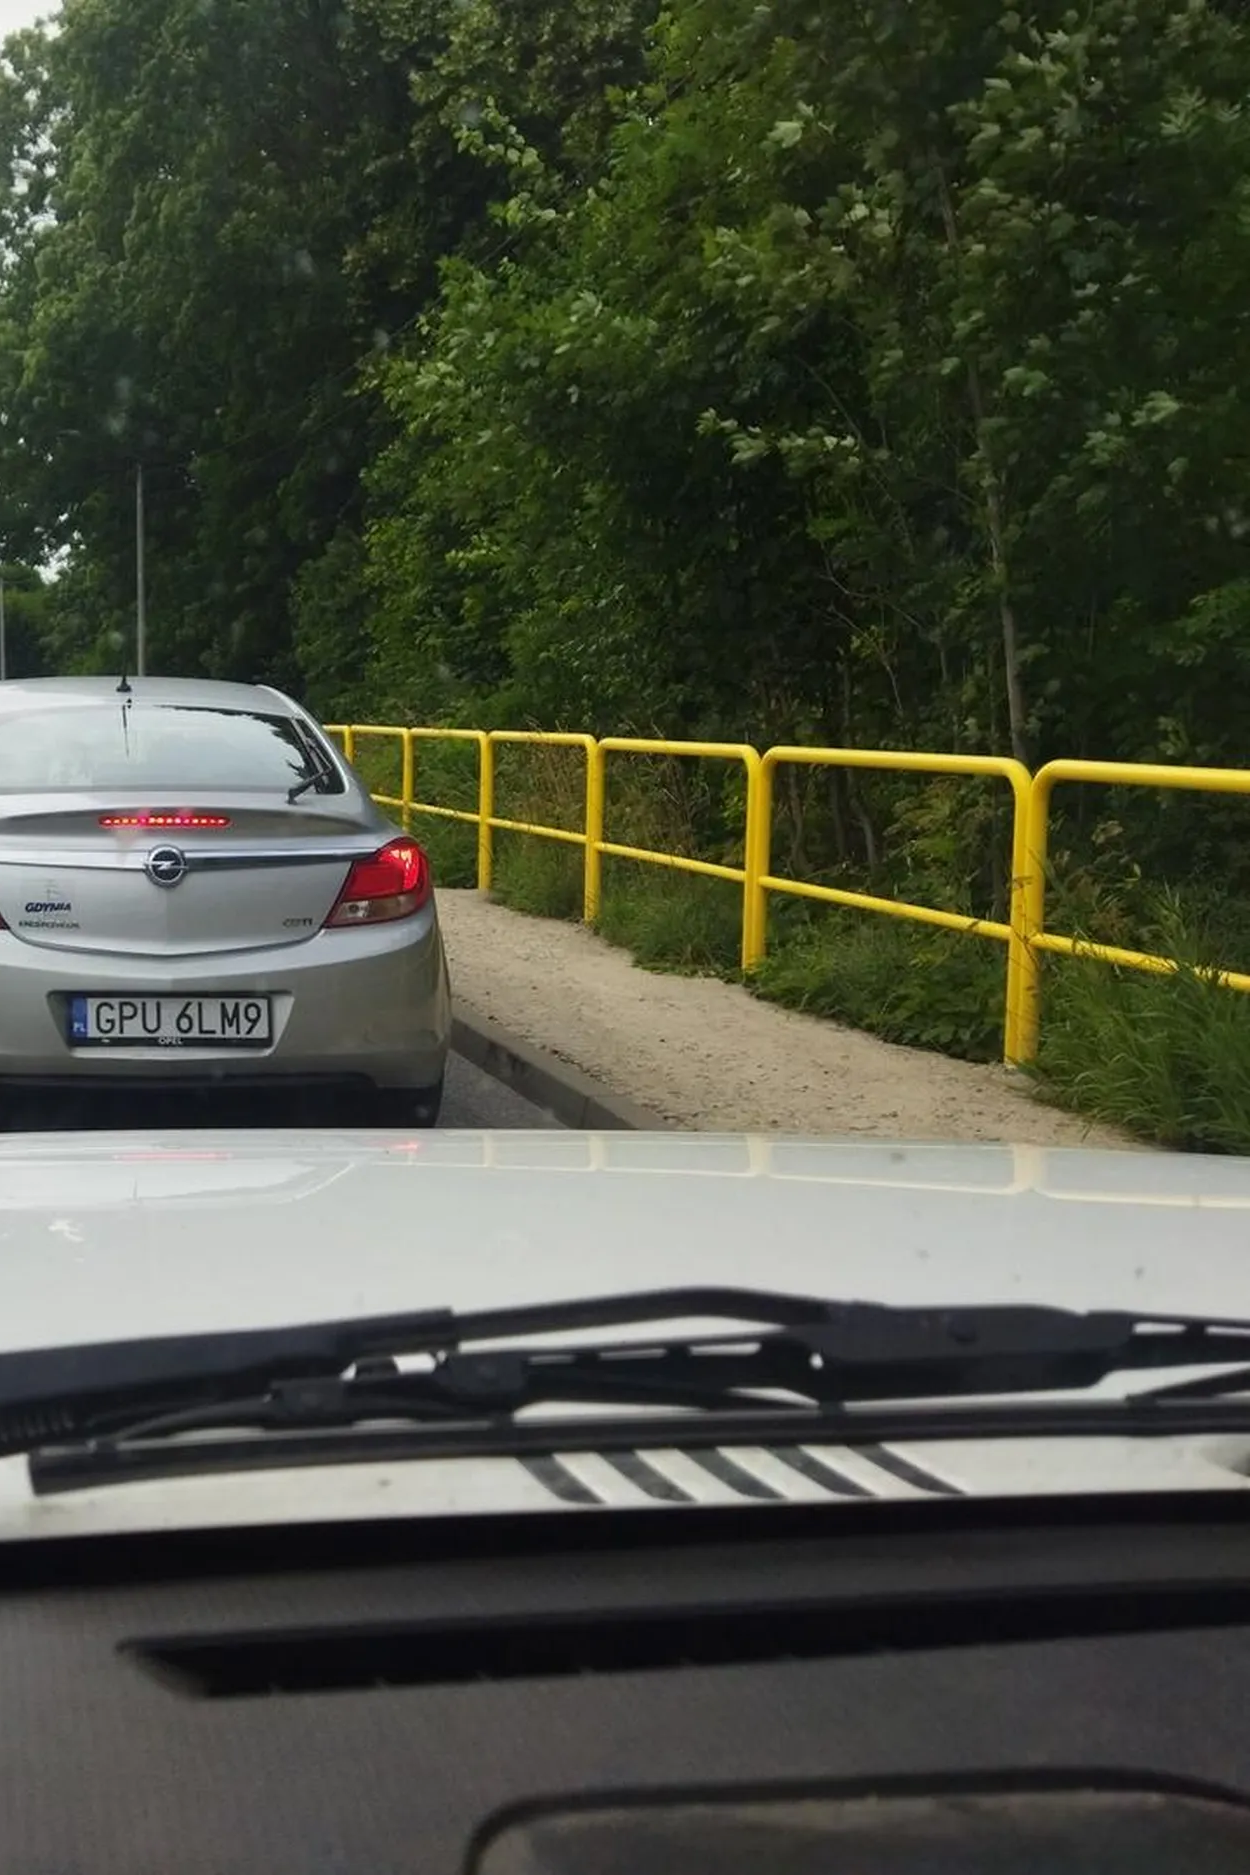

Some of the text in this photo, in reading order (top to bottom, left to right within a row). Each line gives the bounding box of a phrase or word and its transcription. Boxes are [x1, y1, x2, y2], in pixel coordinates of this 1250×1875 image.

[25, 902, 72, 913] GDYNIA
[95, 1001, 262, 1036] GPU 6LM9
[73, 1022, 86, 1033] PL
[157, 1036, 184, 1046] OPEL
